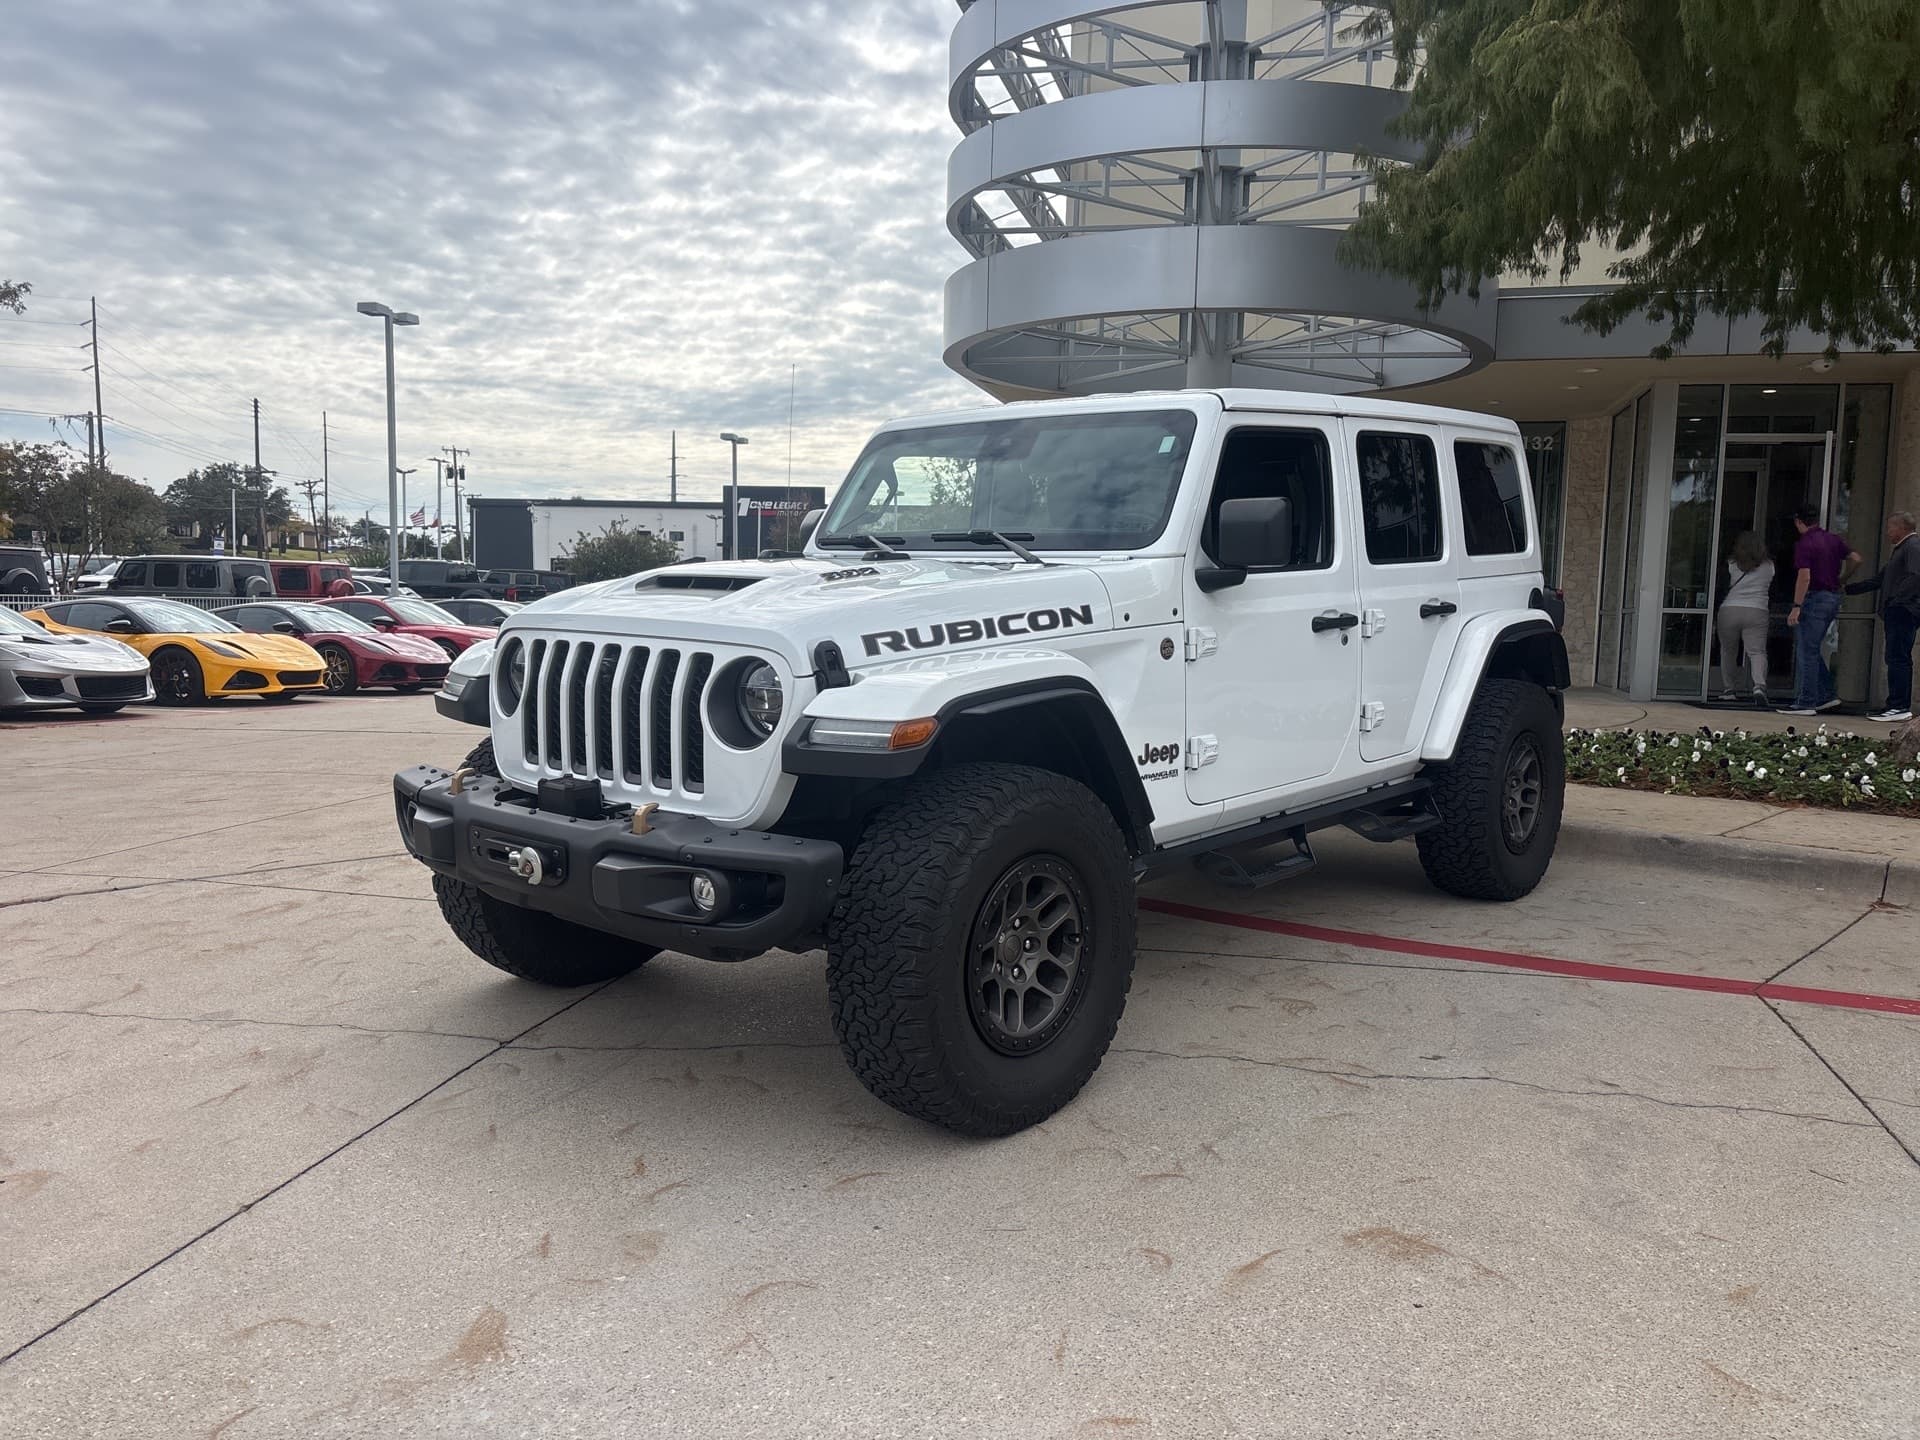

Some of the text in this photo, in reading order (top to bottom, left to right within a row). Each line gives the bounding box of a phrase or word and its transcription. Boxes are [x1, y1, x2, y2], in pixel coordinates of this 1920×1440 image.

[773, 501, 809, 510] LEGACY
[860, 604, 1094, 657] RUBICON
[1137, 742, 1180, 766] Jeep
